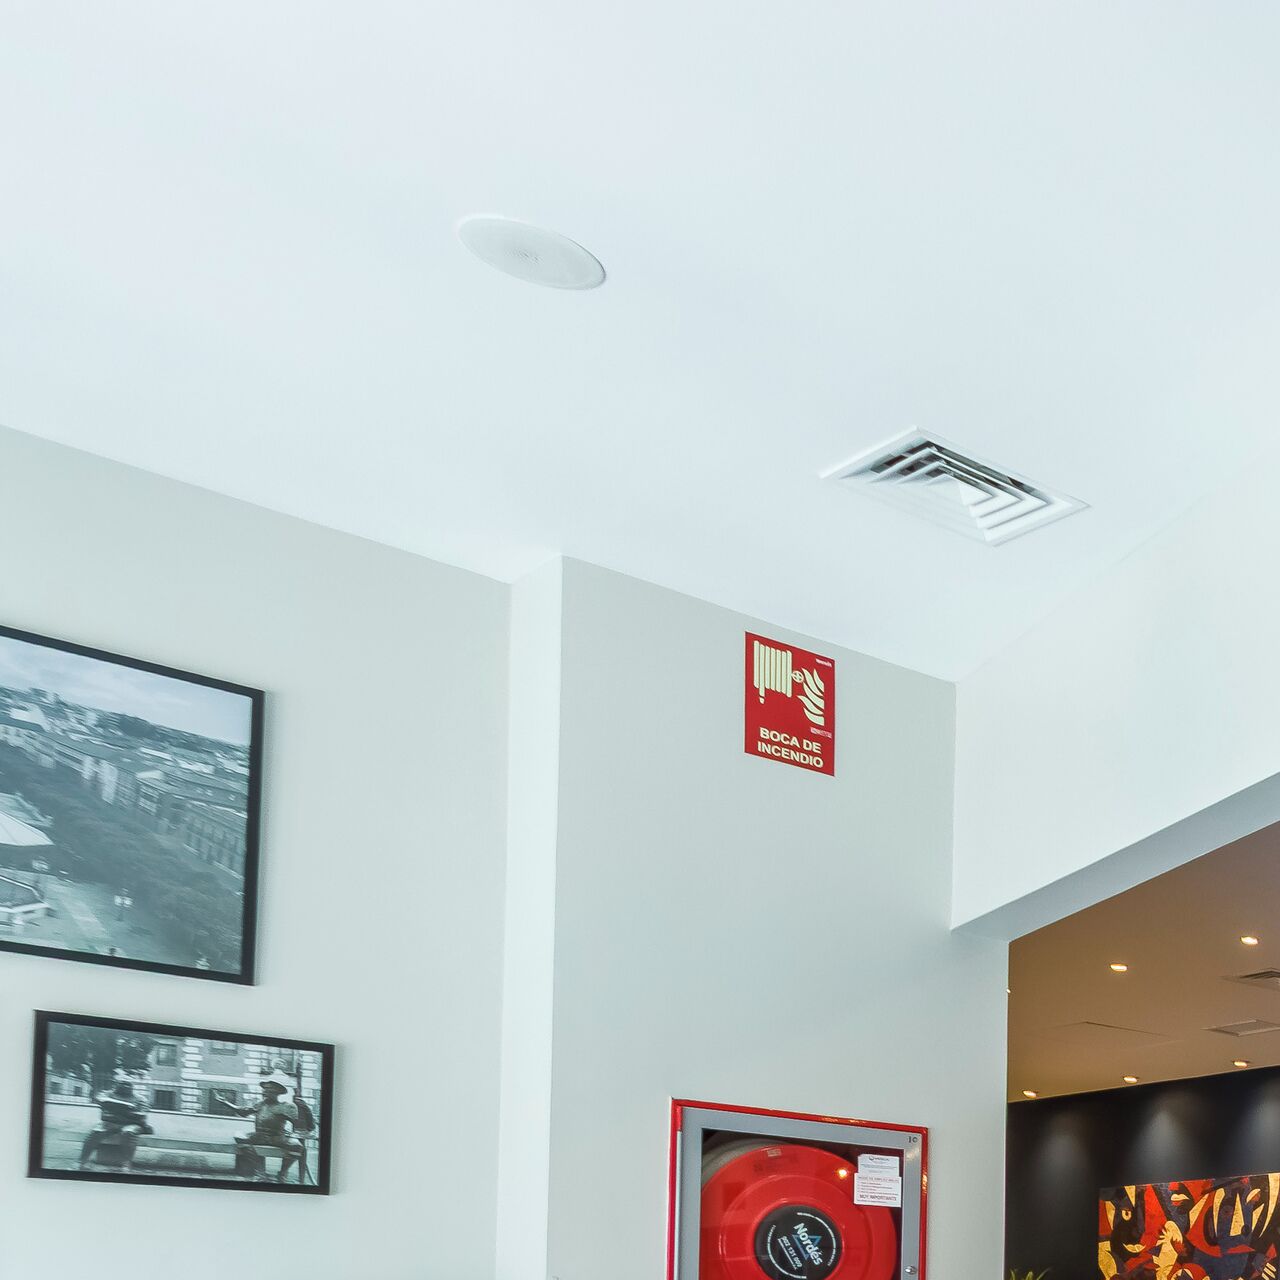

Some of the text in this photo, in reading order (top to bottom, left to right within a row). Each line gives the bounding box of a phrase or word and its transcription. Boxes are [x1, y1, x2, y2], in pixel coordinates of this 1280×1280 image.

[759, 726, 800, 748] BOCA
[803, 739, 822, 754] DE
[757, 741, 824, 768] INCENDIO
[793, 1222, 823, 1266] Nordés
